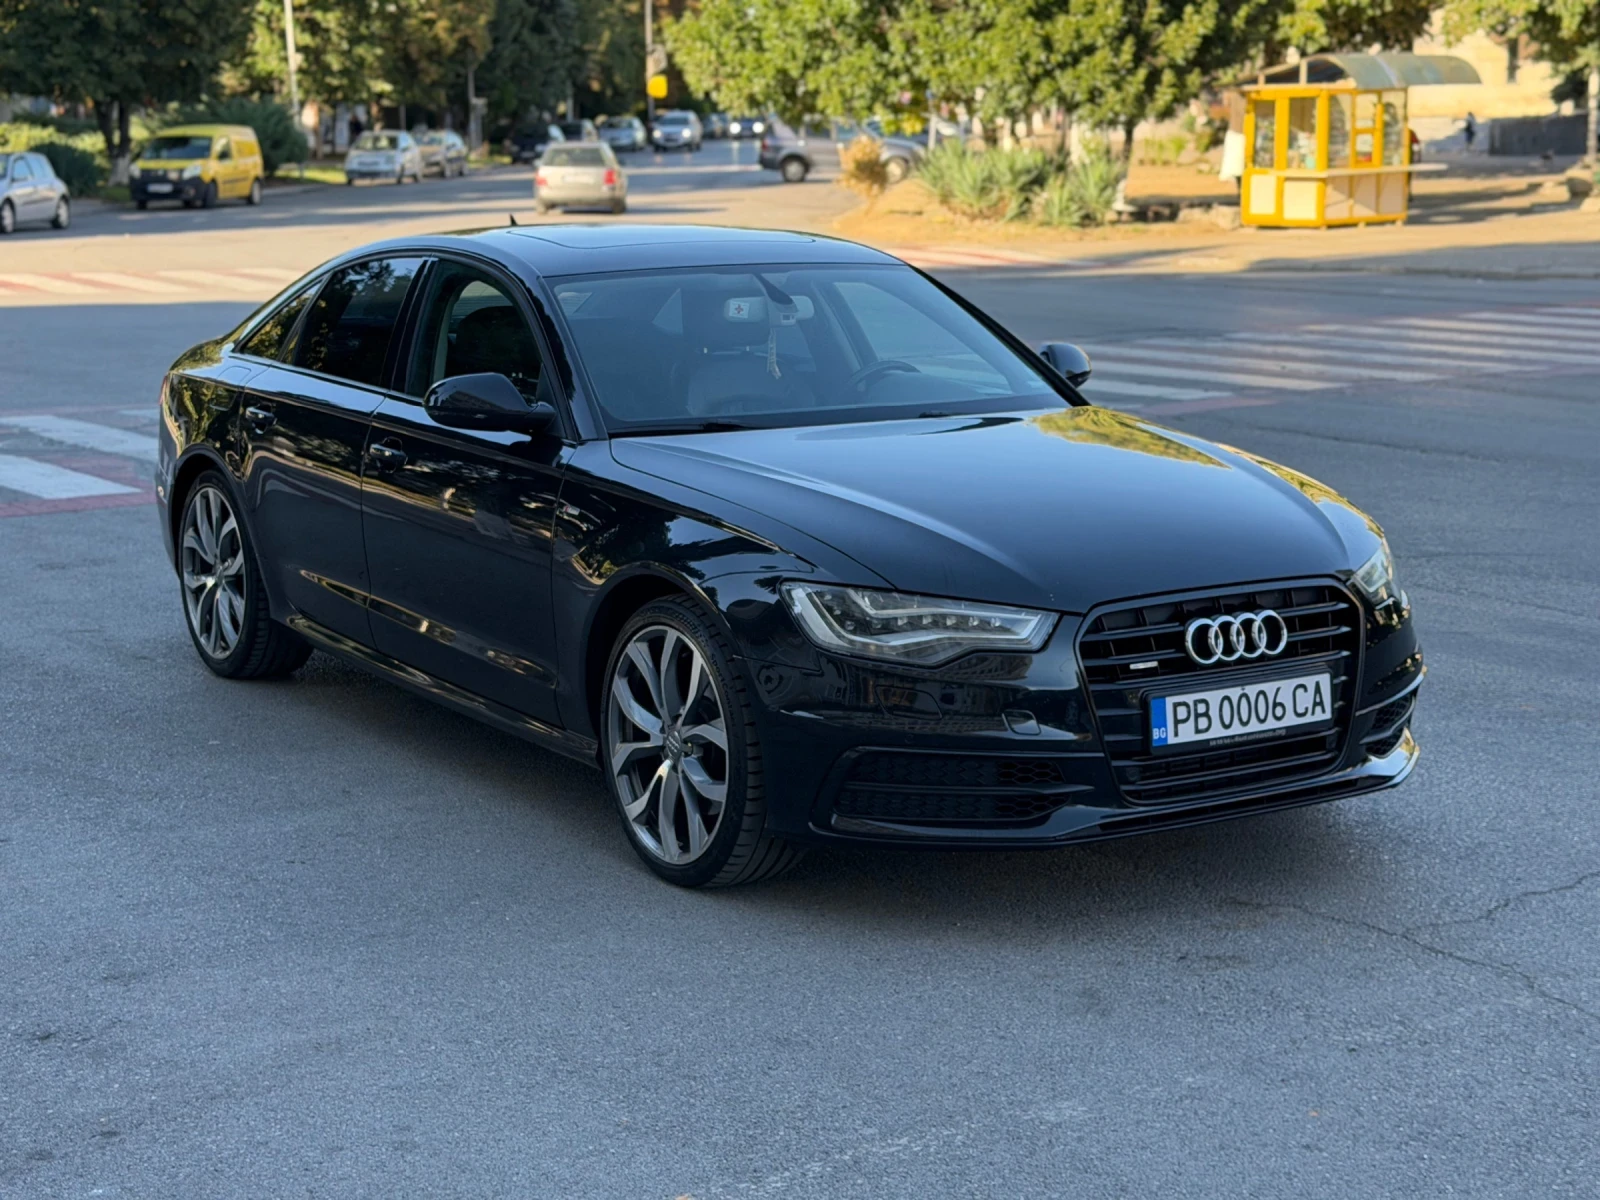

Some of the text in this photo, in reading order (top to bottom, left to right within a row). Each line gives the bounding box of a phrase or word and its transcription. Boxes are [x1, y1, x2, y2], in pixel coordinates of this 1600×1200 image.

[1172, 698, 1213, 738] PB
[1218, 686, 1287, 730] 0006
[1292, 680, 1327, 718] CA
[1152, 727, 1167, 740] BG
